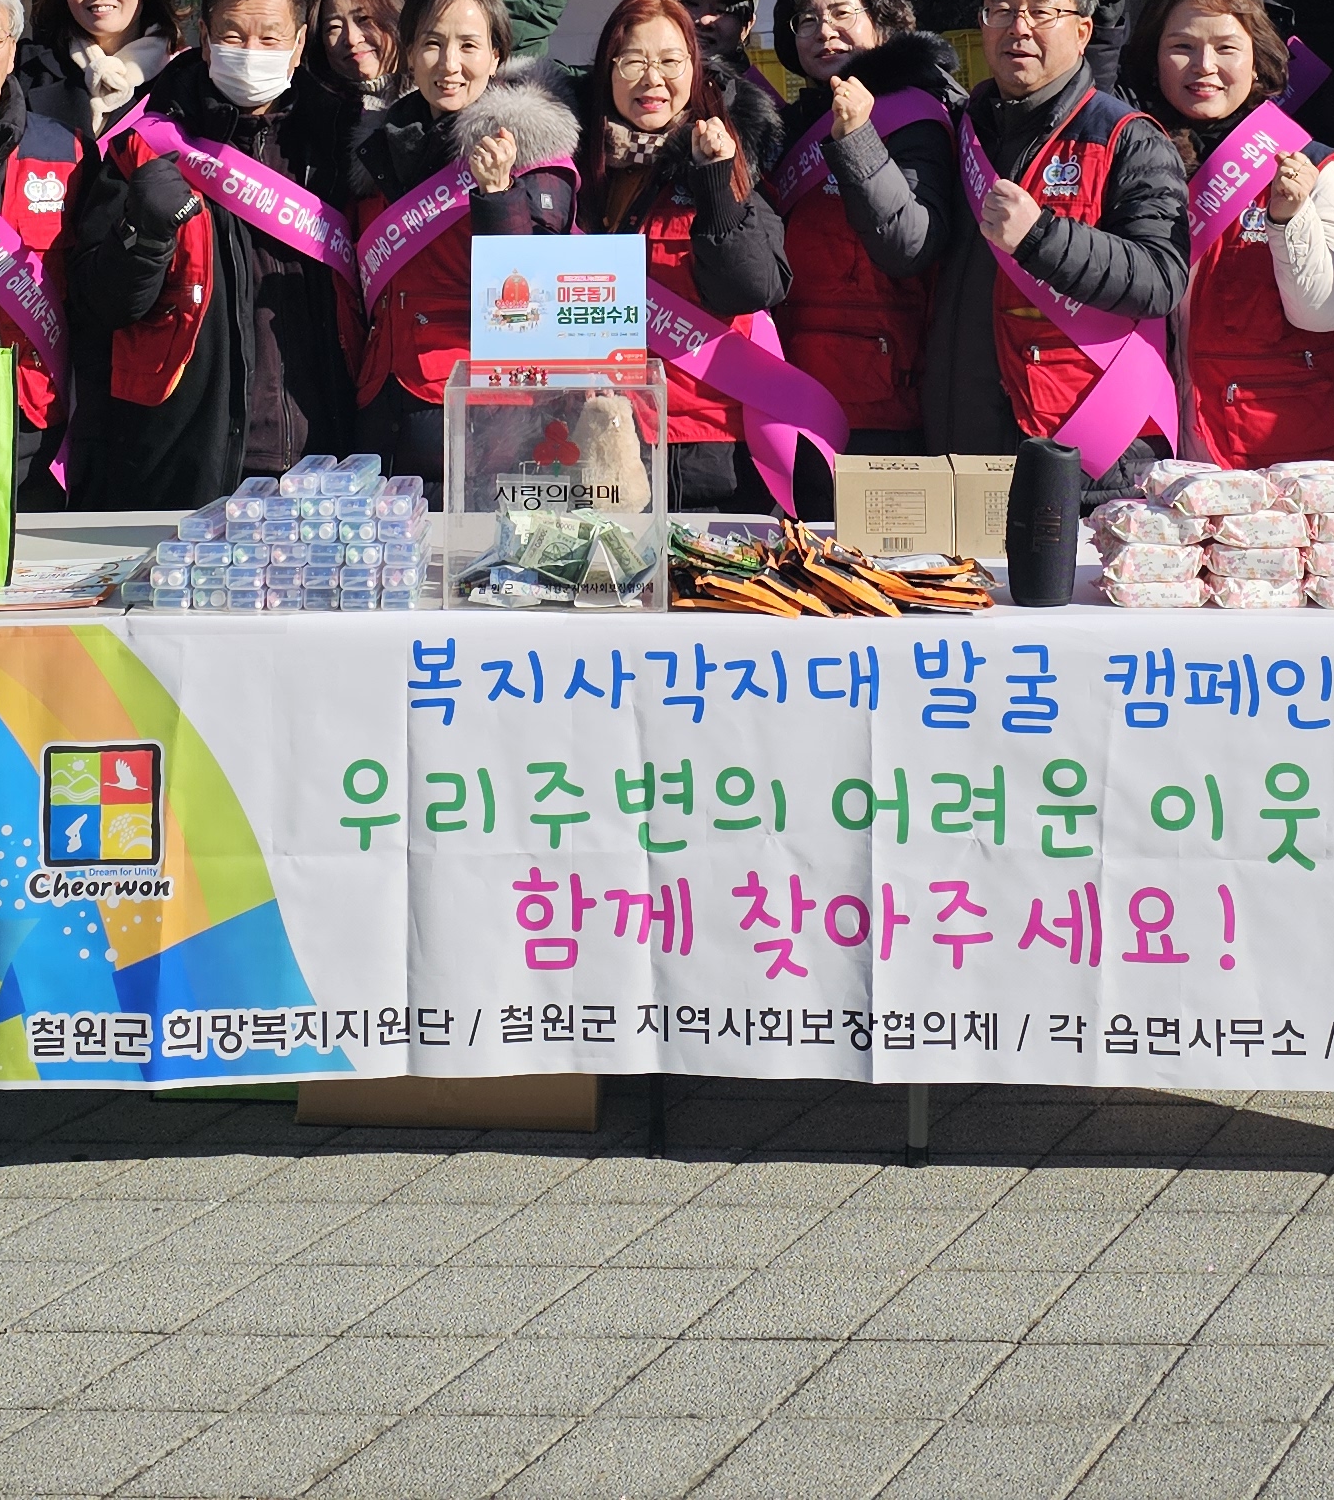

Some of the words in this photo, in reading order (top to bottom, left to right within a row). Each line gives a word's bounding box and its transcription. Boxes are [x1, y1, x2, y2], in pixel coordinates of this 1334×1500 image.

[221, 166, 282, 216] 어려운
[1195, 161, 1251, 218] 어려운
[556, 306, 639, 325] 성금접수처
[493, 484, 620, 511] 사랑의열매
[407, 636, 880, 726] 복지사각지대
[912, 638, 1061, 735] 발굴
[1103, 646, 1334, 731] 캠페인
[831, 758, 1098, 860] 어려운
[28, 870, 171, 900] Cheorwon
[89, 866, 118, 878] Dream
[119, 866, 132, 878] for
[133, 866, 159, 880] Unity
[512, 865, 695, 970] 함께
[732, 867, 1238, 981] 찾아주세요!
[30, 1017, 150, 1058] 철원군
[168, 1008, 455, 1056] 희망복지지원단
[499, 1004, 618, 1045] 철원군
[635, 1002, 1001, 1054] 지역사회보장협의체
[1048, 1015, 1088, 1053] 각
[1103, 1014, 1309, 1060] 읍면사무소
